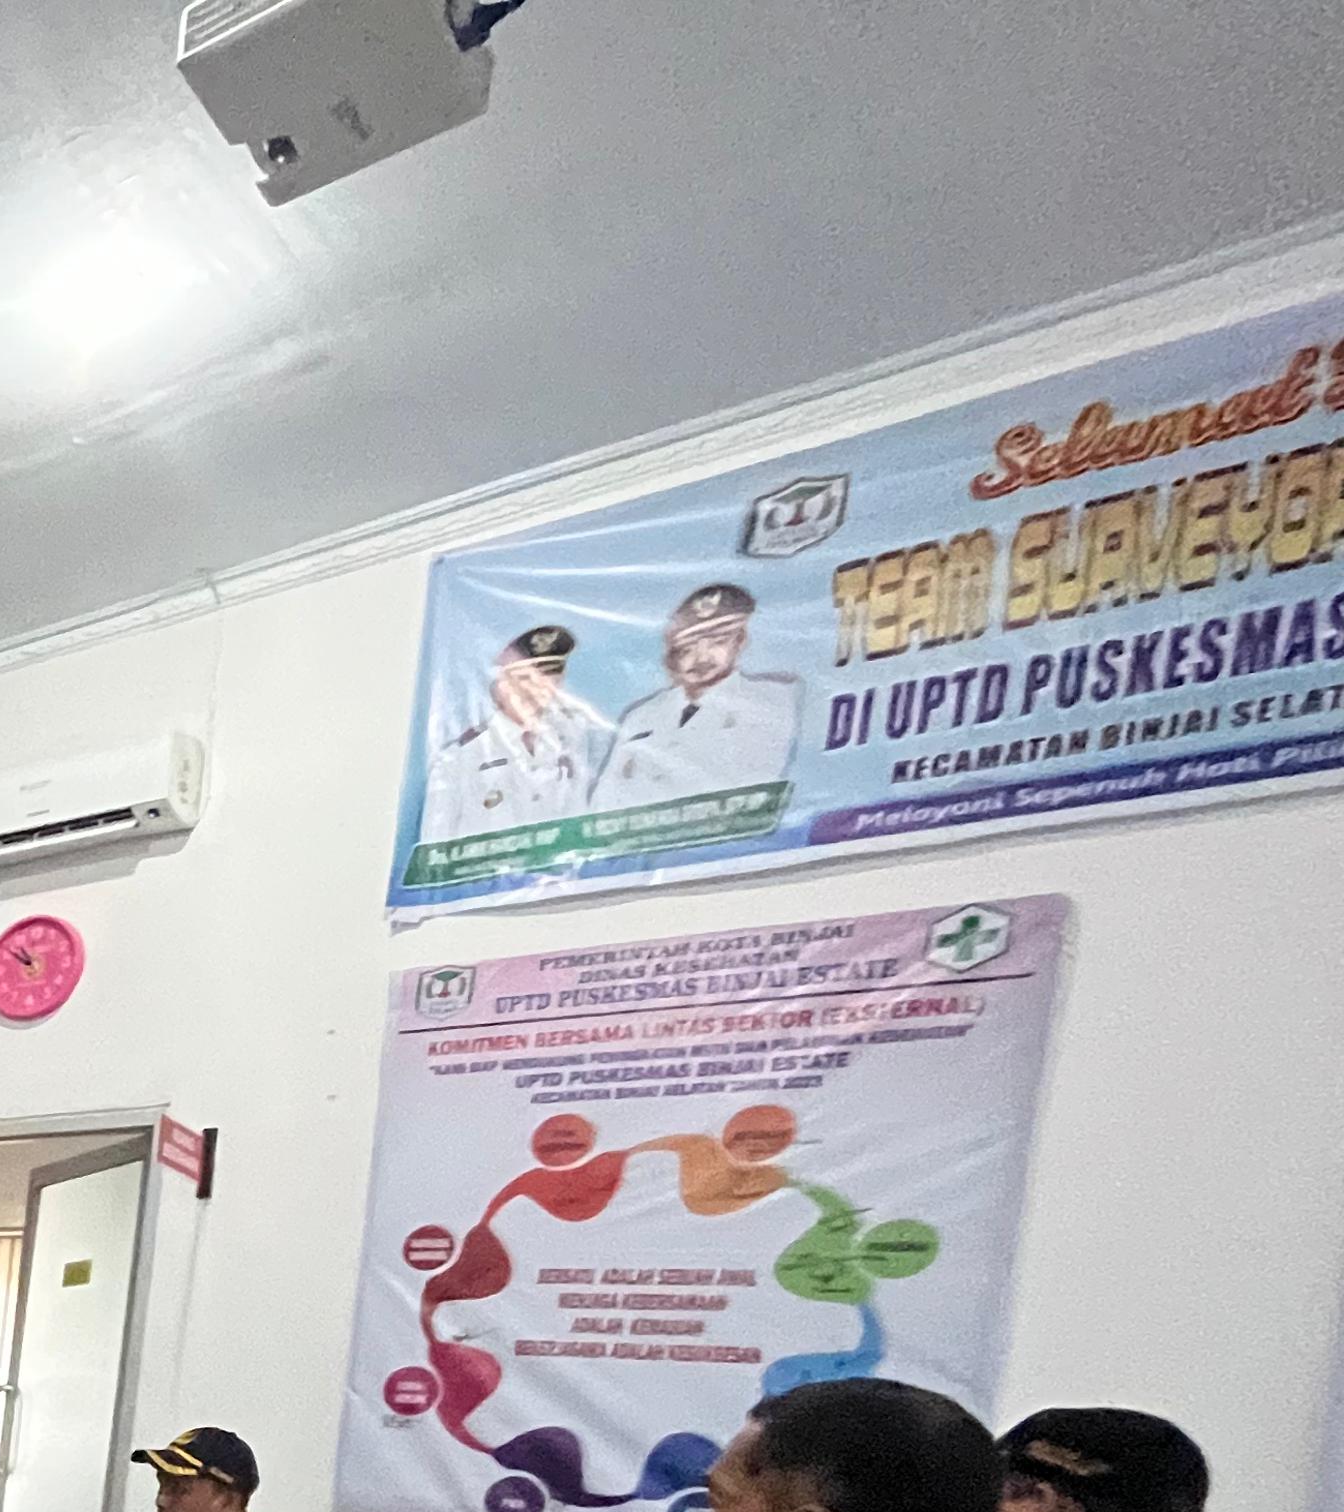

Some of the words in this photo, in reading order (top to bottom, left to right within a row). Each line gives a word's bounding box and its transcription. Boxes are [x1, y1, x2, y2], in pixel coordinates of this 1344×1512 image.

[969, 345, 1320, 501] Selamat
[824, 688, 876, 751] DI
[884, 663, 1010, 740] UPTD
[891, 730, 1090, 784] KECAMATAN
[1098, 706, 1221, 752] BINJAI
[539, 941, 692, 971] PEMERINTAH
[698, 935, 762, 956] KOTA
[770, 923, 855, 946] BINJAI
[495, 993, 551, 1014] UPTD
[557, 977, 699, 1008] PUSKESMAS
[706, 968, 791, 993] BINJAI
[796, 957, 899, 986] ESTATE
[577, 965, 646, 985] DINAS
[427, 1032, 529, 1056] KOMITMEN
[534, 1024, 634, 1047] BERSAMA
[641, 1015, 713, 1038] LINTAS
[721, 1009, 813, 1033] SEKTOR
[515, 1071, 563, 1089] UPTD
[567, 1063, 692, 1086] PUSKESMAS
